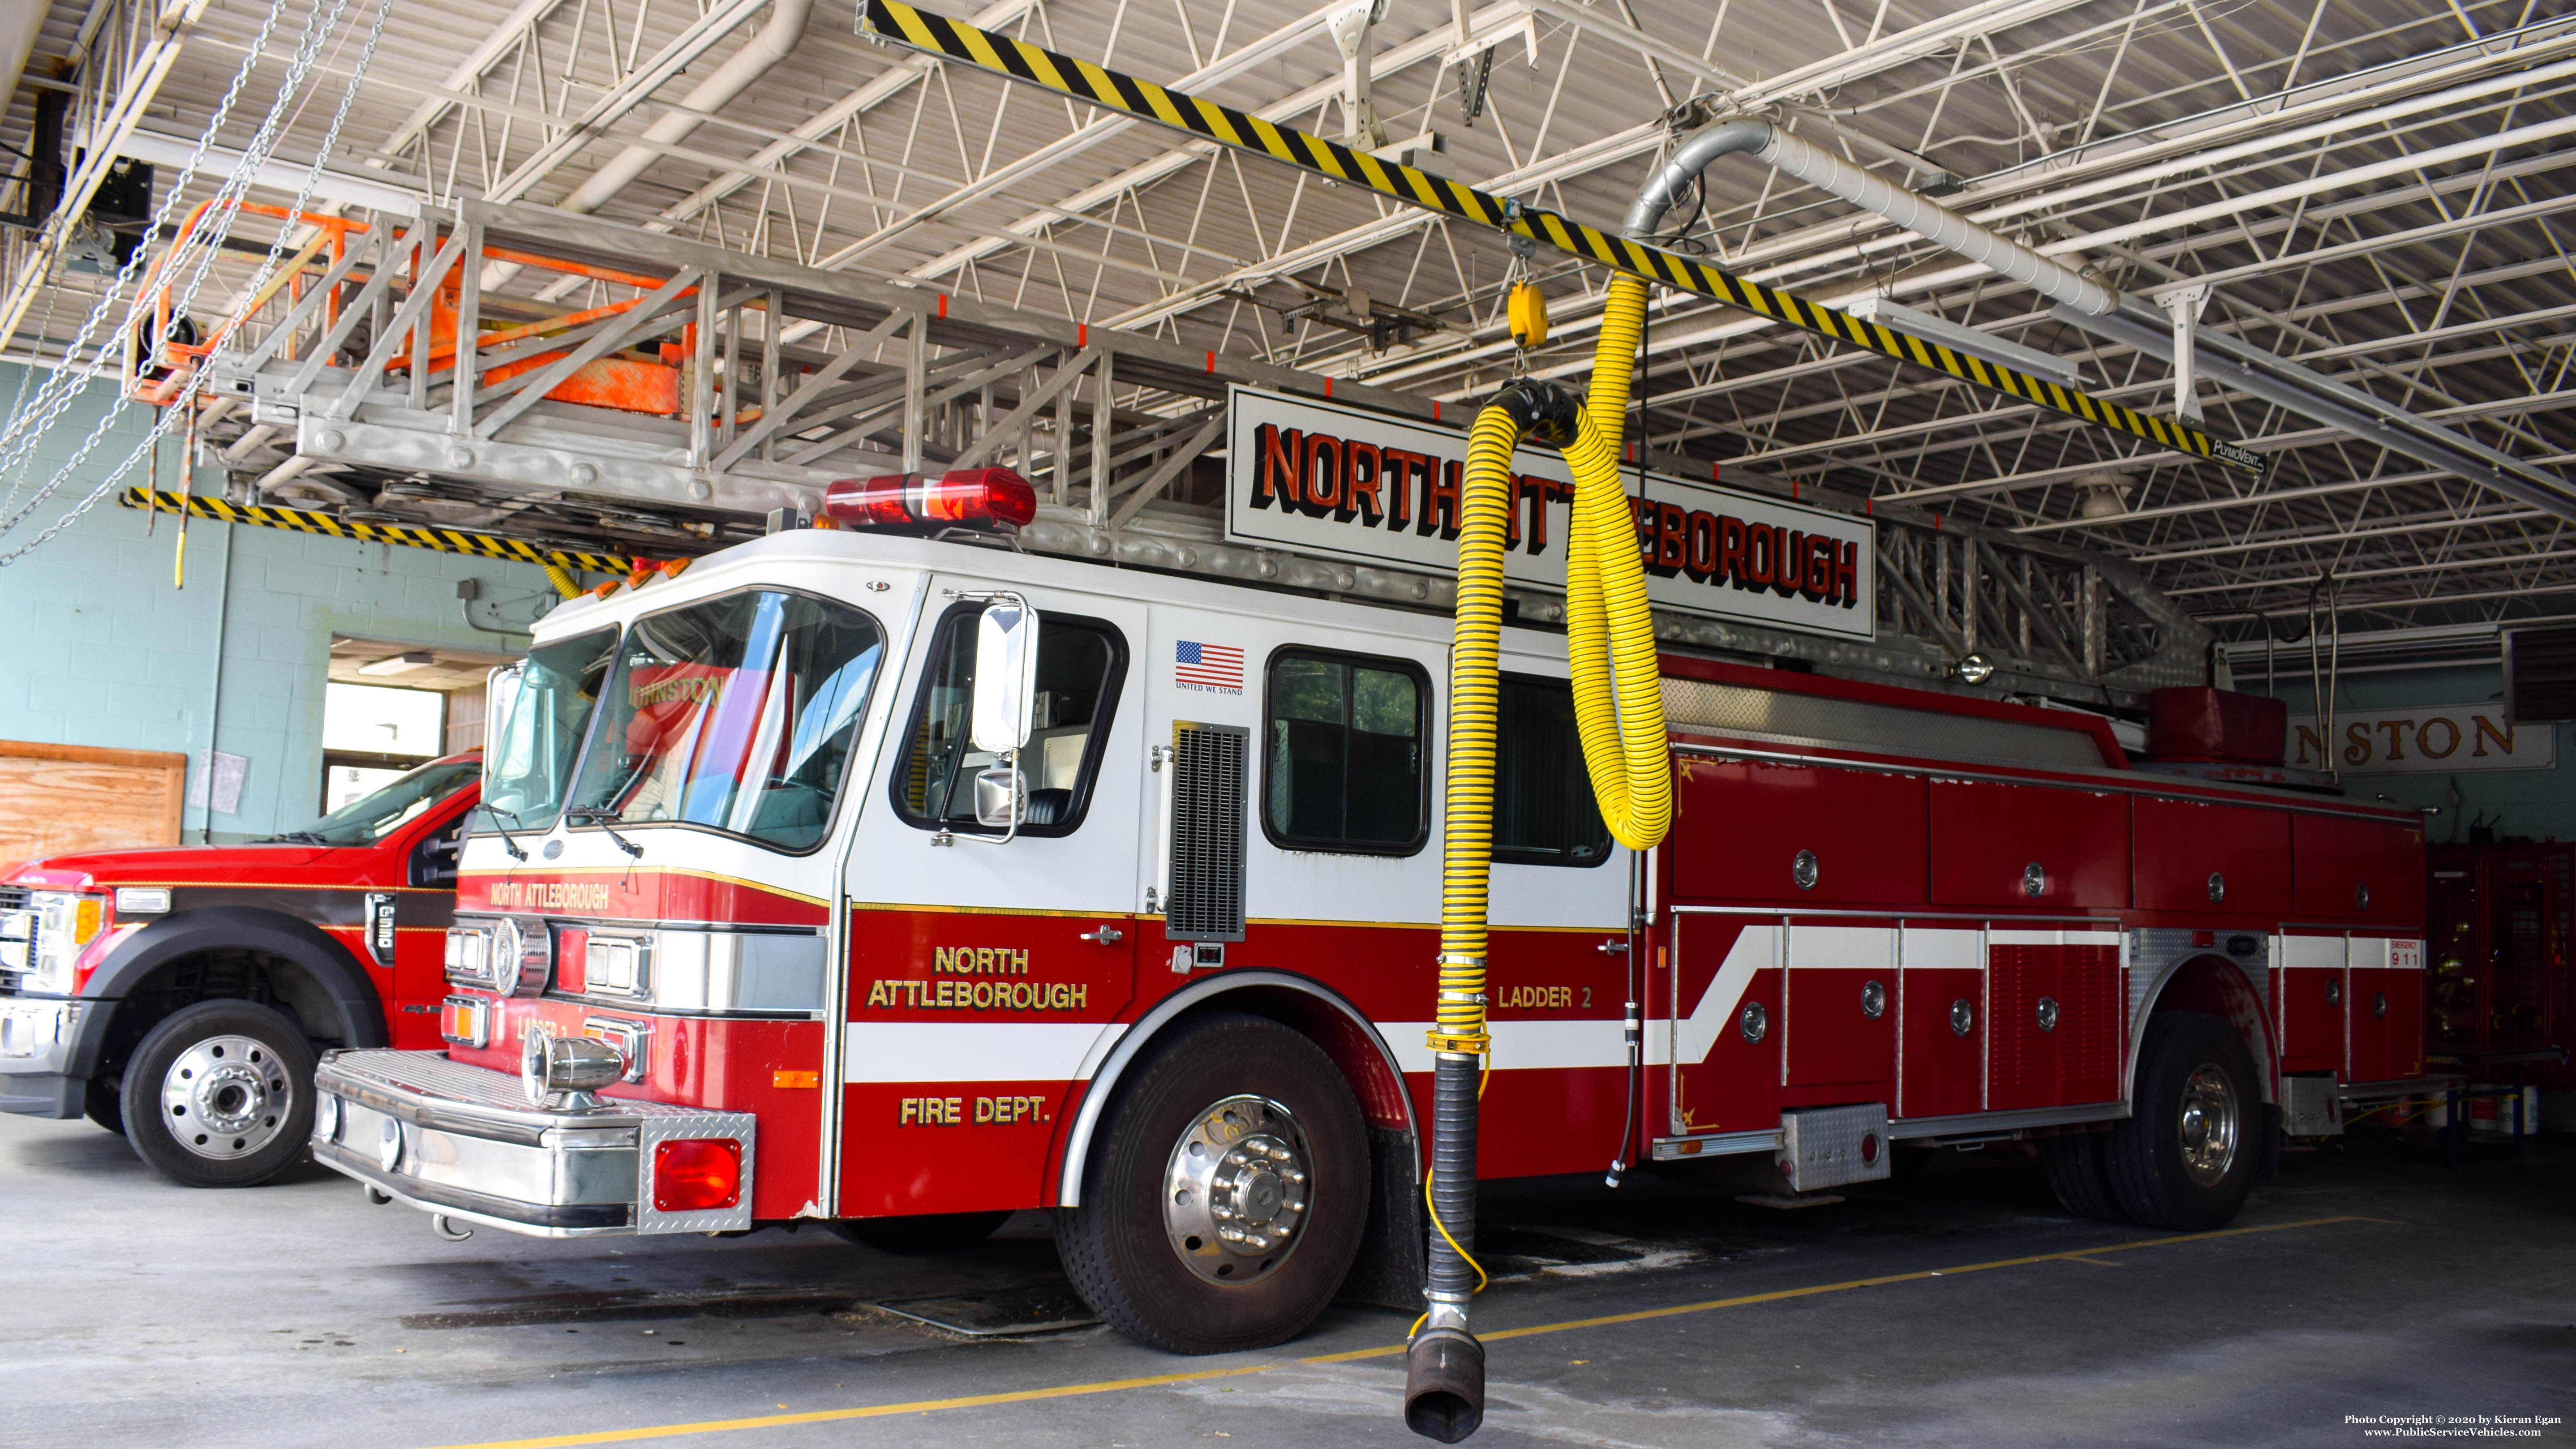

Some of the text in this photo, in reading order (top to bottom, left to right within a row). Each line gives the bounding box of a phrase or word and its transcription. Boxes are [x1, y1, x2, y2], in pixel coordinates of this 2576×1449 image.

[1250, 422, 1858, 609] NORTH ATEBOROUGH
[1176, 682, 1203, 691] UNITED
[1219, 687, 1242, 695] STAND
[491, 883, 609, 909] NORTH ATTLEBOROUGH
[934, 947, 1029, 975] NORTH
[865, 980, 1087, 1011] ATTLEBOROUGH
[1498, 986, 1592, 1009] LADDER 2
[898, 1097, 1049, 1126] FIRE DEPT.
